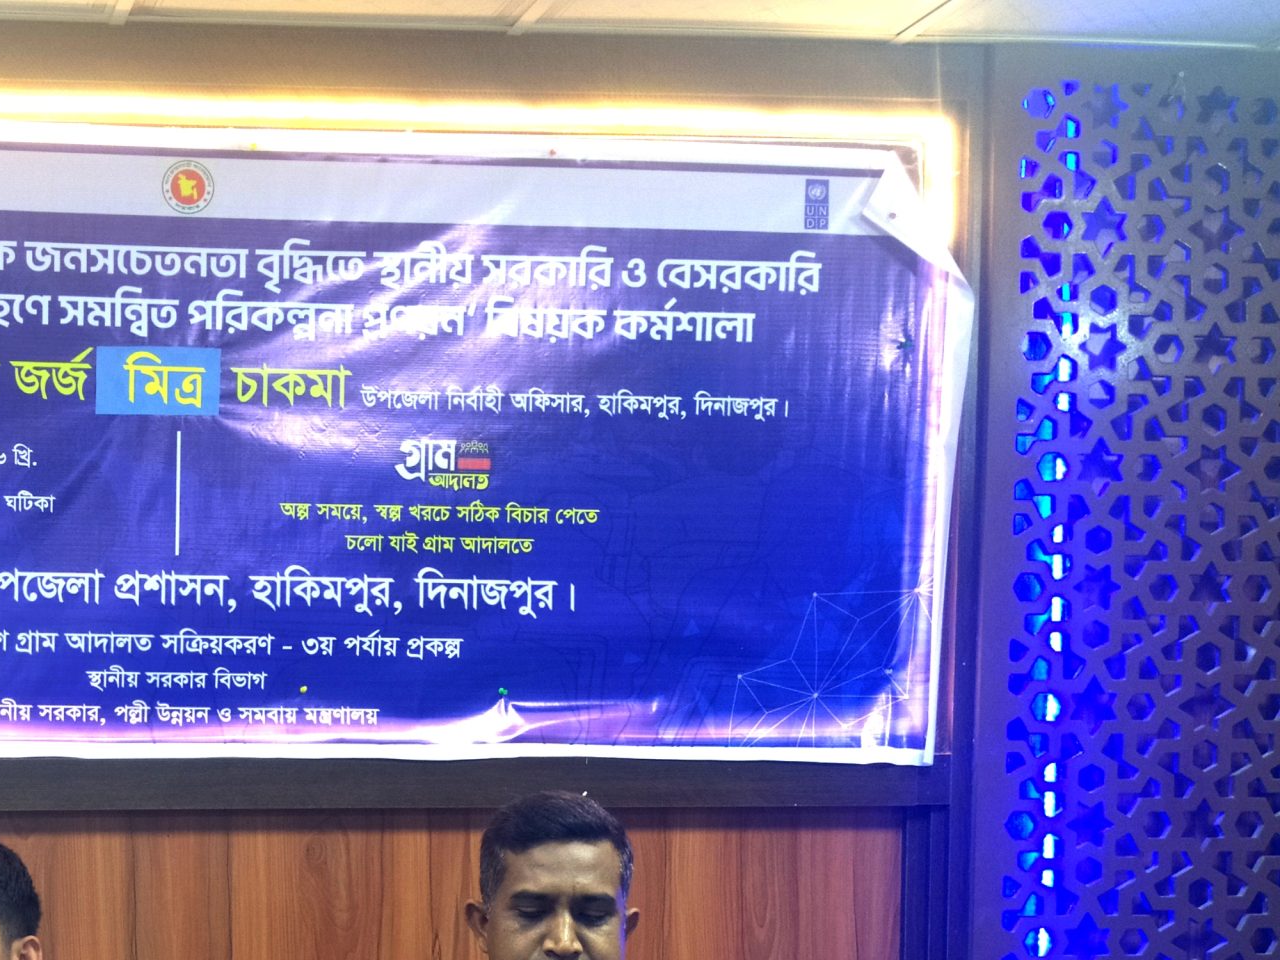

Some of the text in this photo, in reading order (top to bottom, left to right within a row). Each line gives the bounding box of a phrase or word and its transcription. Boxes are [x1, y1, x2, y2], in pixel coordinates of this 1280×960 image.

[24, 241, 249, 279] জনসচেতনতা
[255, 238, 366, 294] বৃদ্ধিতে
[373, 240, 474, 290] স্থানীয়
[481, 245, 614, 291] সরকারি
[621, 258, 647, 288] ও
[657, 250, 822, 295] বেসরকারি
[59, 286, 179, 337] সমন্বিত
[188, 289, 354, 341] পরিকল্পনা
[484, 295, 607, 343] বিষয়ক
[614, 298, 755, 342] কর্মশালা
[10, 347, 94, 400] জর্জ
[124, 351, 206, 408] মিত্র
[230, 363, 352, 410] চাকমা
[360, 383, 440, 410] উপজেলা
[445, 384, 504, 414] নির্বাহী
[510, 388, 590, 417] অফিসার,
[598, 390, 687, 420] হাকিমপুর,
[394, 439, 457, 482] গ্রাম
[428, 472, 490, 491] আদালত
[4, 490, 56, 513] ঘটিকা
[280, 499, 600, 525] অল্প সময়ে, স্বল্প খরচে সঠিক বিচার পেতে
[345, 532, 534, 554] চলো যাই গ্রাম আদালতে
[114, 570, 238, 613] প্রশাসন,
[249, 564, 403, 615] হাকিমপুর,
[15, 632, 56, 654] গ্রাম
[65, 633, 154, 654] আদালত
[161, 628, 275, 656] সক্রিয়করণ
[301, 638, 335, 656] ৩য়
[344, 631, 398, 657] পর্যায়
[407, 637, 463, 660] প্রকল্প
[86, 664, 267, 692] স্থানীয় সরকার বিভাগ
[38, 704, 106, 724] সরকার,
[114, 702, 151, 725] পল্লী
[156, 704, 208, 726] উন্নয়ন
[219, 708, 231, 723] ও
[239, 707, 295, 726] সমবায়
[305, 706, 379, 727] মন্ত্রণালয়
